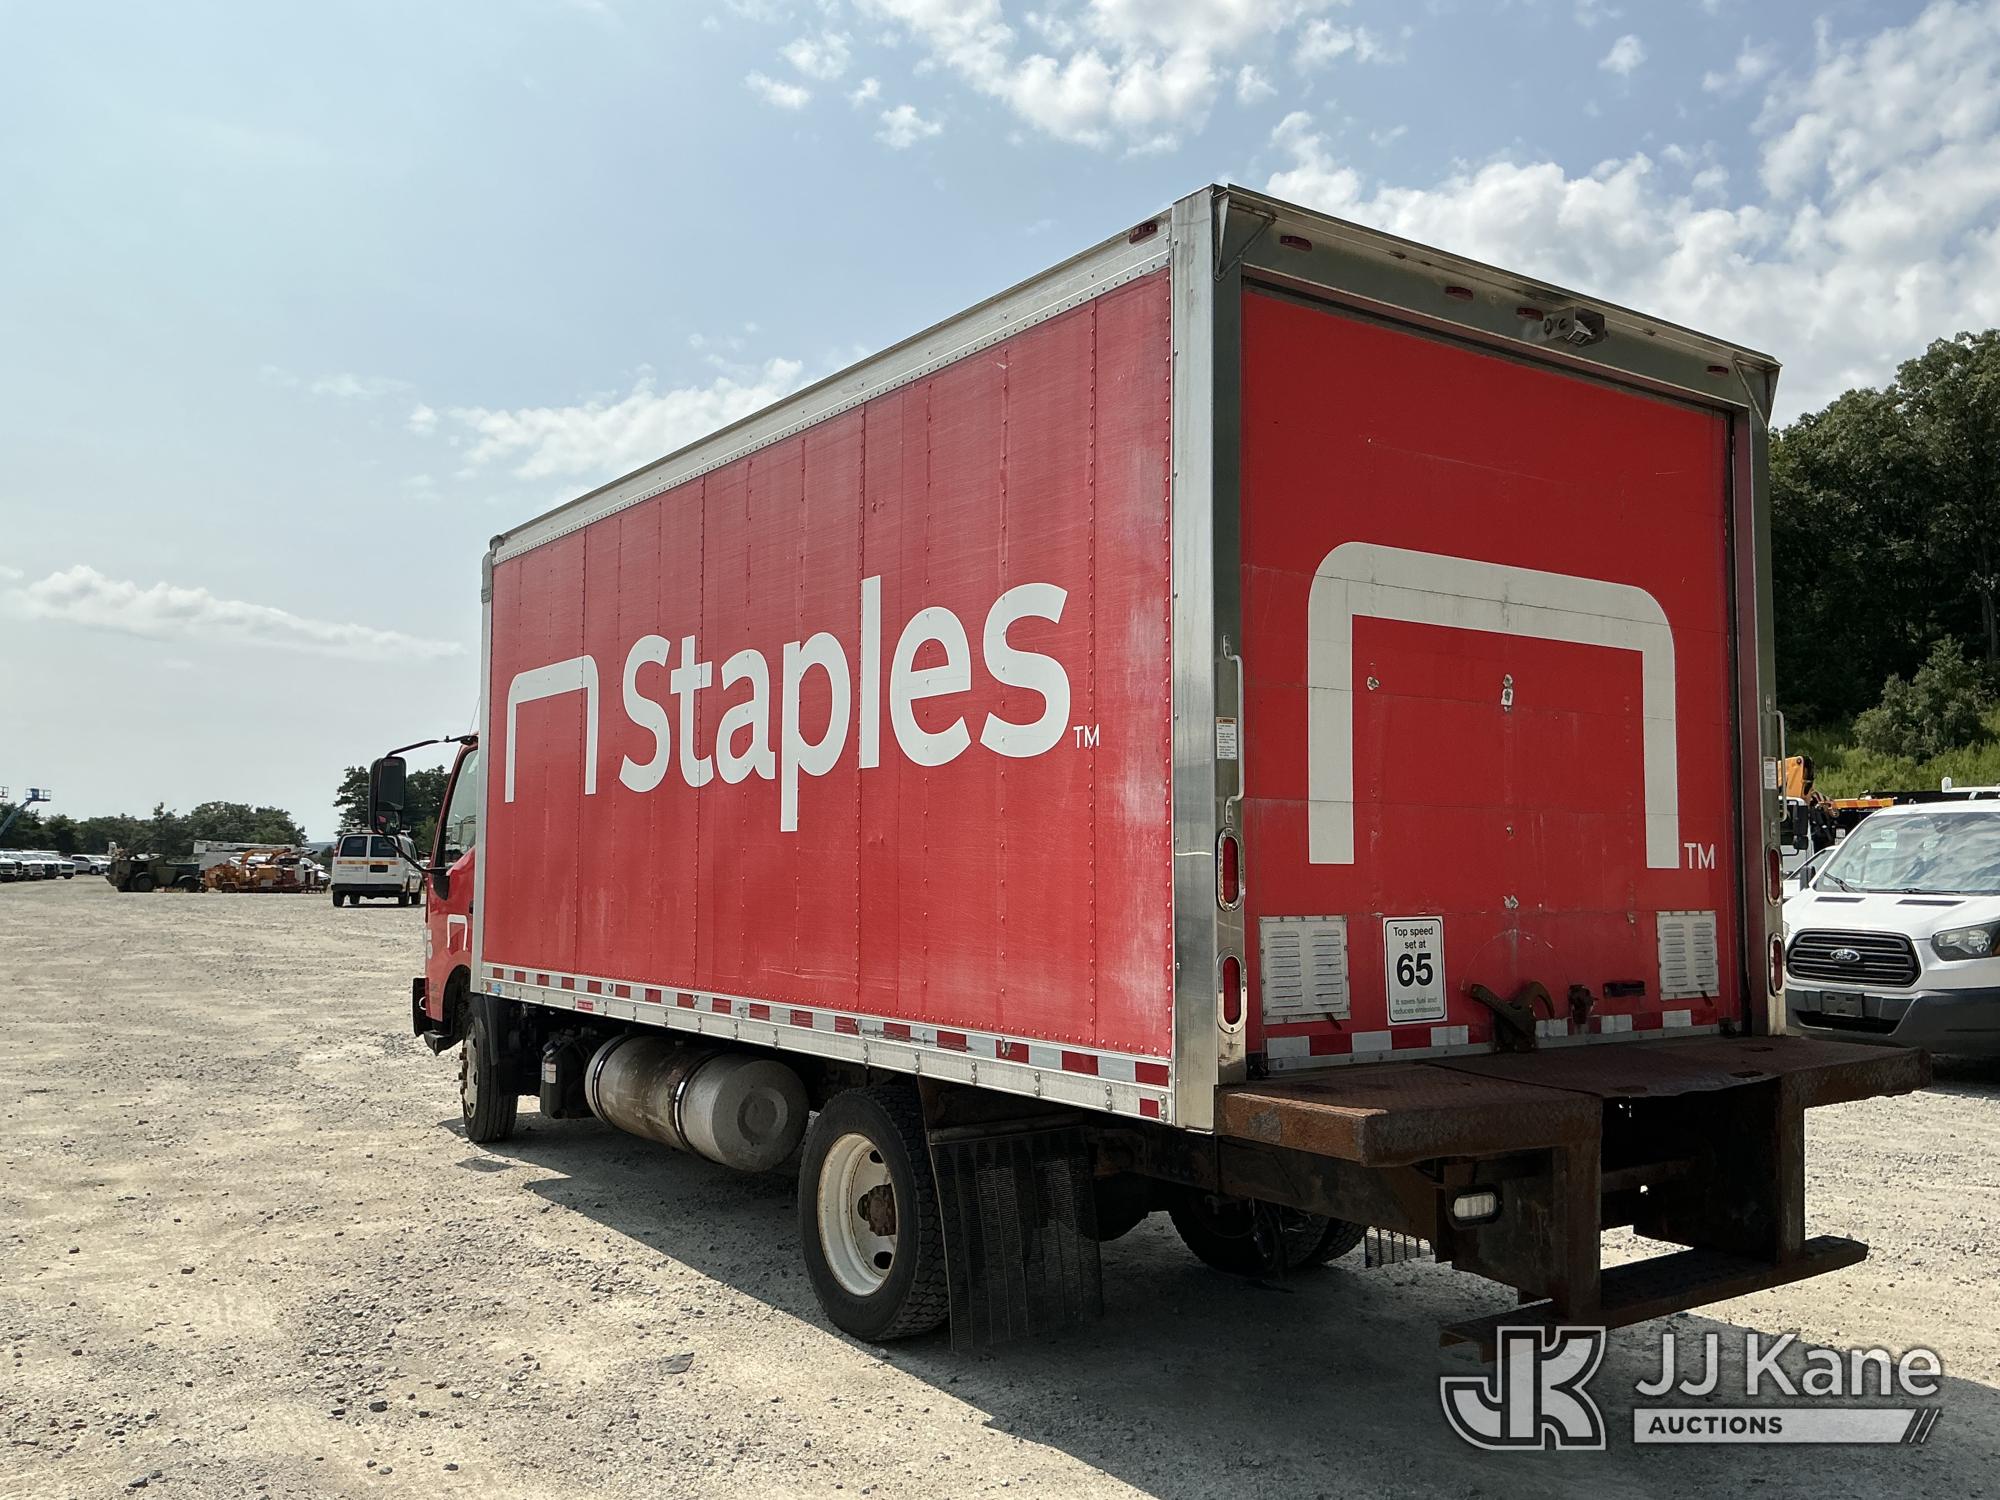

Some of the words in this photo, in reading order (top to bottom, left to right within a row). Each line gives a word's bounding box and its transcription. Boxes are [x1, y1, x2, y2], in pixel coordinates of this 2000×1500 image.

[618, 575, 1071, 833] Staples
[1072, 723, 1100, 749] TM
[1683, 842, 1715, 870] TM
[1393, 926, 1408, 938] Top
[1410, 926, 1434, 938] speed
[1404, 940, 1417, 950] set
[1418, 939, 1427, 949] at
[1396, 952, 1434, 988] 65
